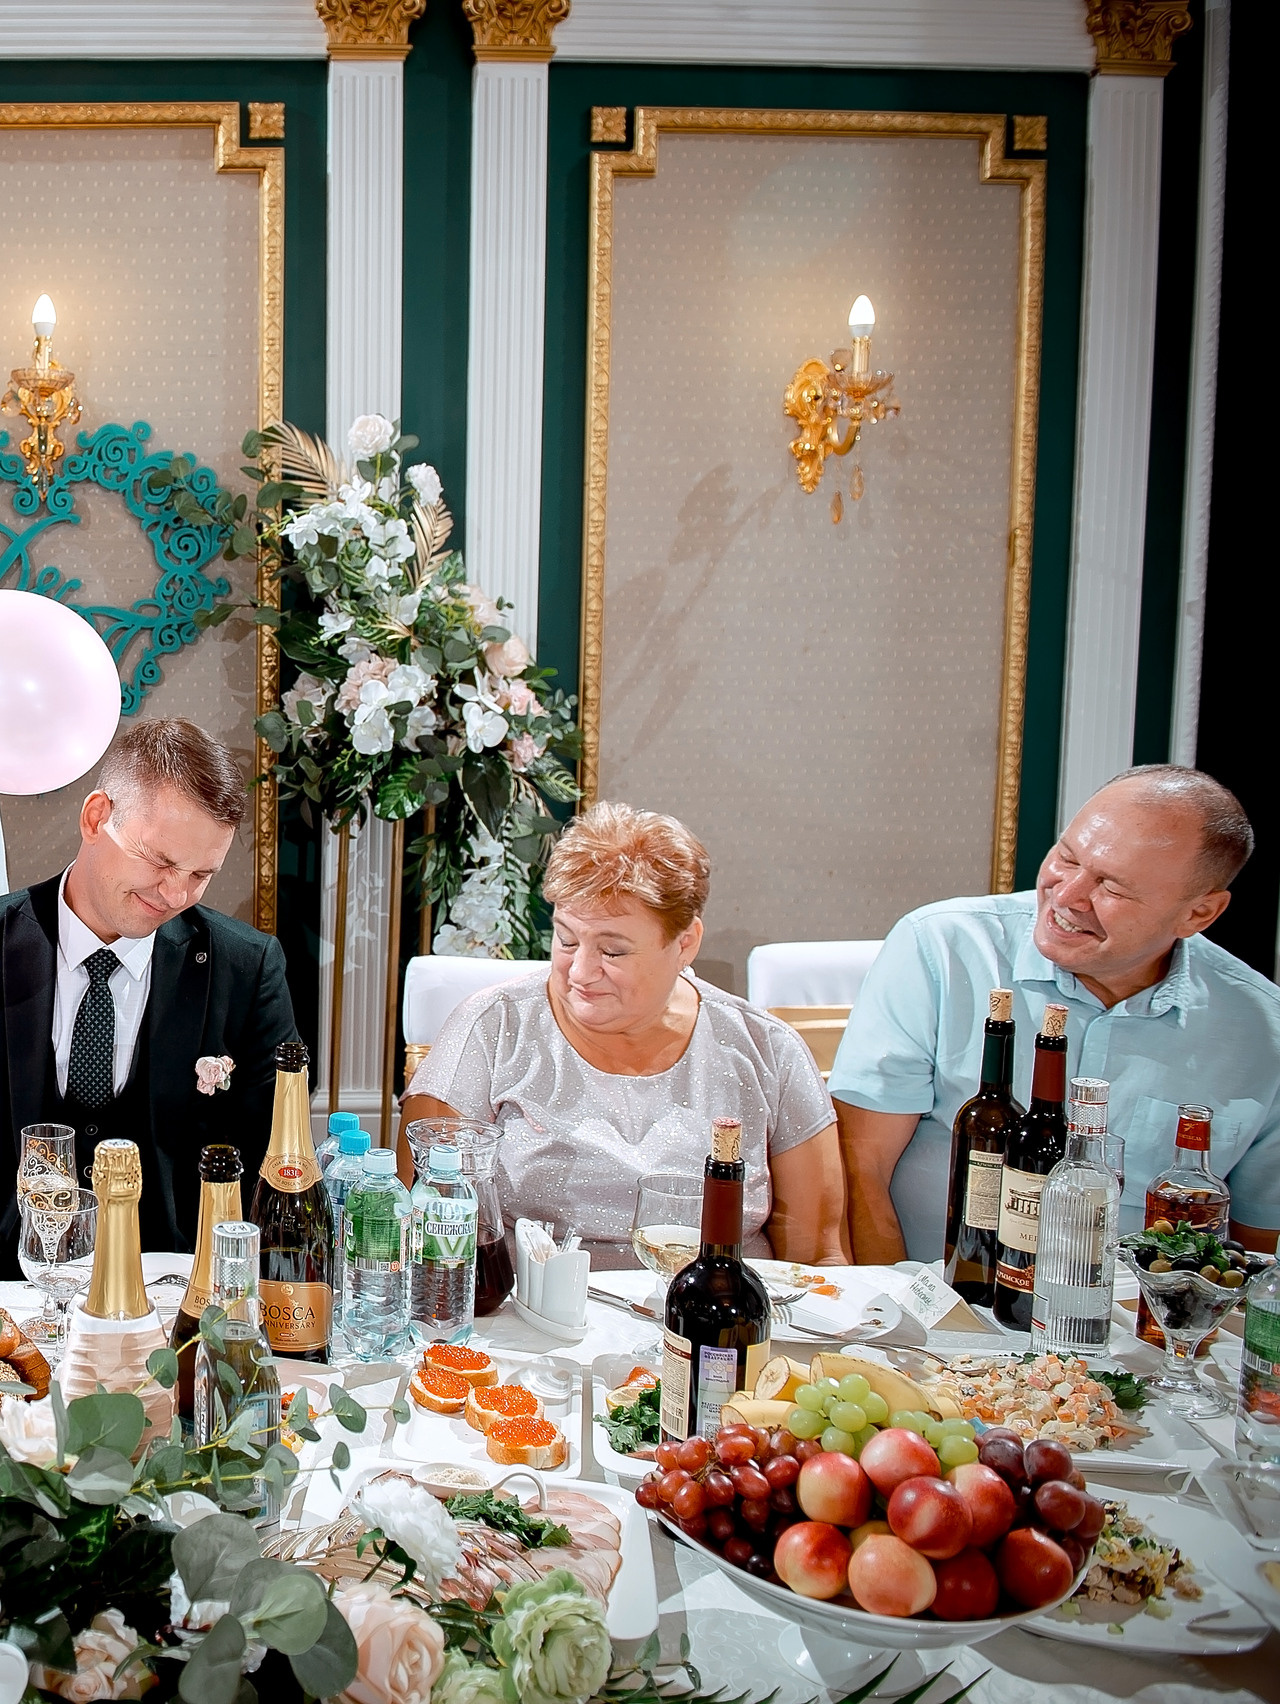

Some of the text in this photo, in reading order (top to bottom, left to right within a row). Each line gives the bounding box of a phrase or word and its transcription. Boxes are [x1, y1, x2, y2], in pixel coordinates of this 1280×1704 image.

[283, 1169, 298, 1177] 1831
[194, 1295, 211, 1307] BOS
[260, 1302, 316, 1321] BOSCA
[263, 1319, 316, 1330] NNIVERSARY
